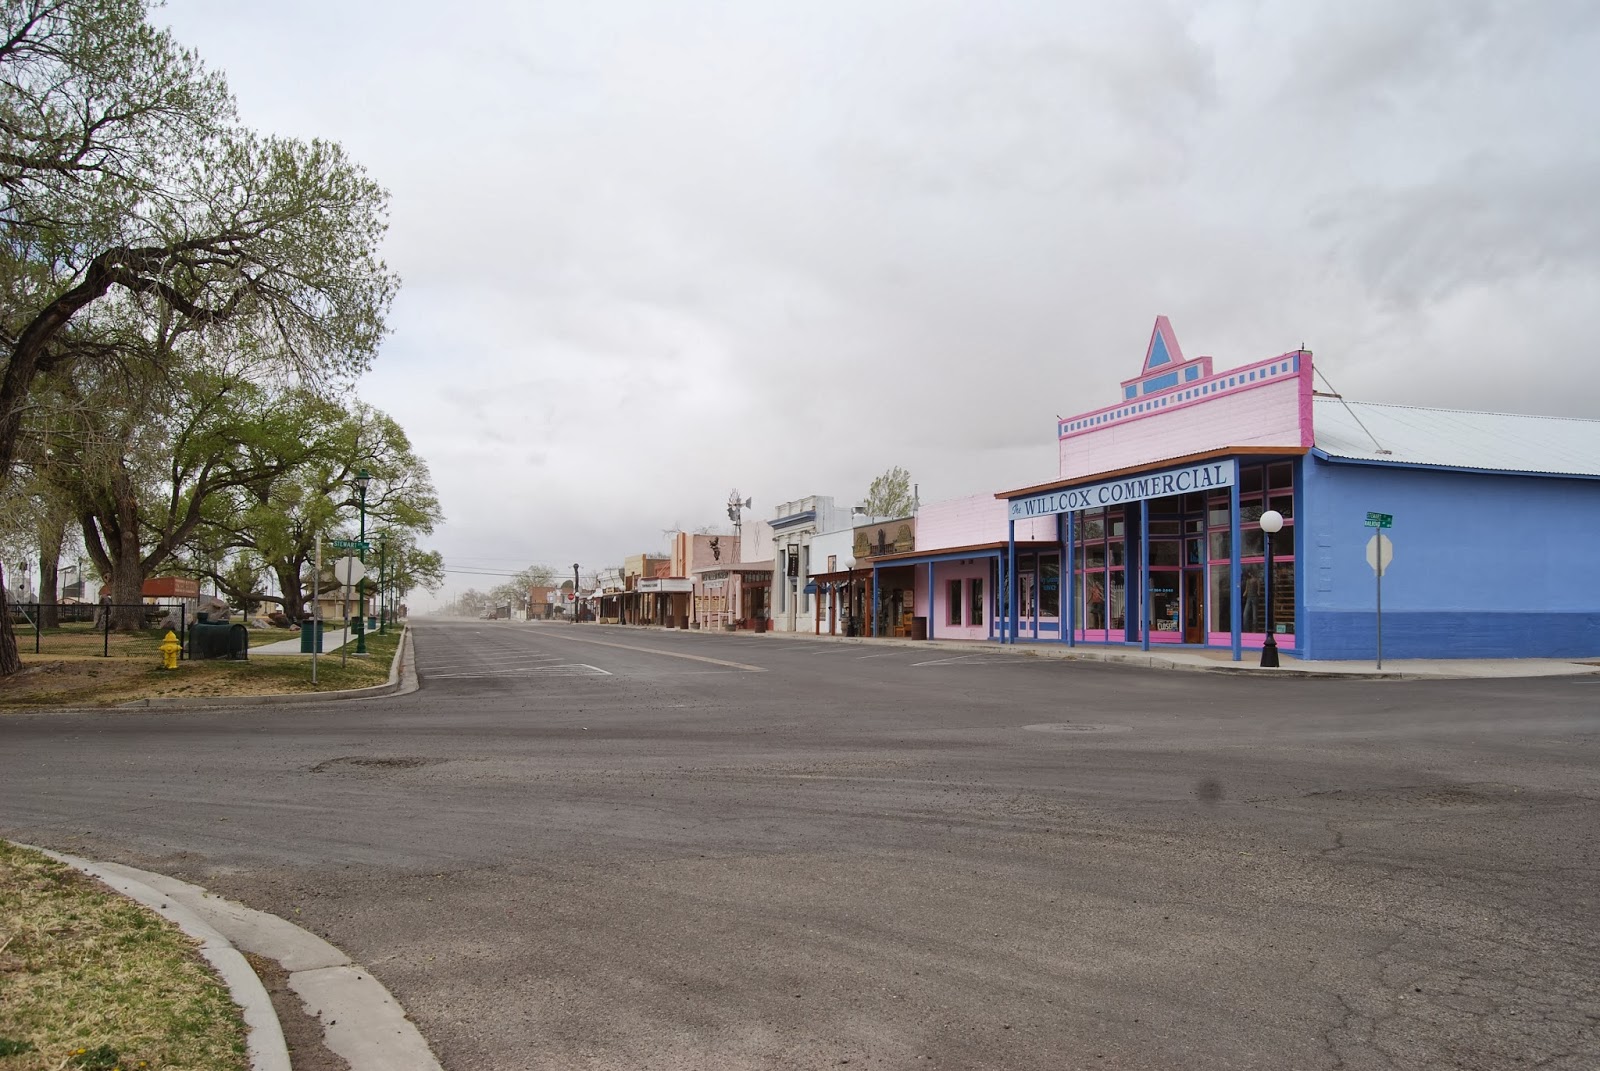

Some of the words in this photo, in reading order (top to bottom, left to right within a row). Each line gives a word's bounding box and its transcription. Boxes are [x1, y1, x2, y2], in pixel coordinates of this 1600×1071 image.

[1011, 502, 1022, 515] The
[1024, 488, 1092, 516] WILLCOX
[1098, 465, 1227, 504] COMMERCIAL
[333, 540, 357, 549] STEWART
